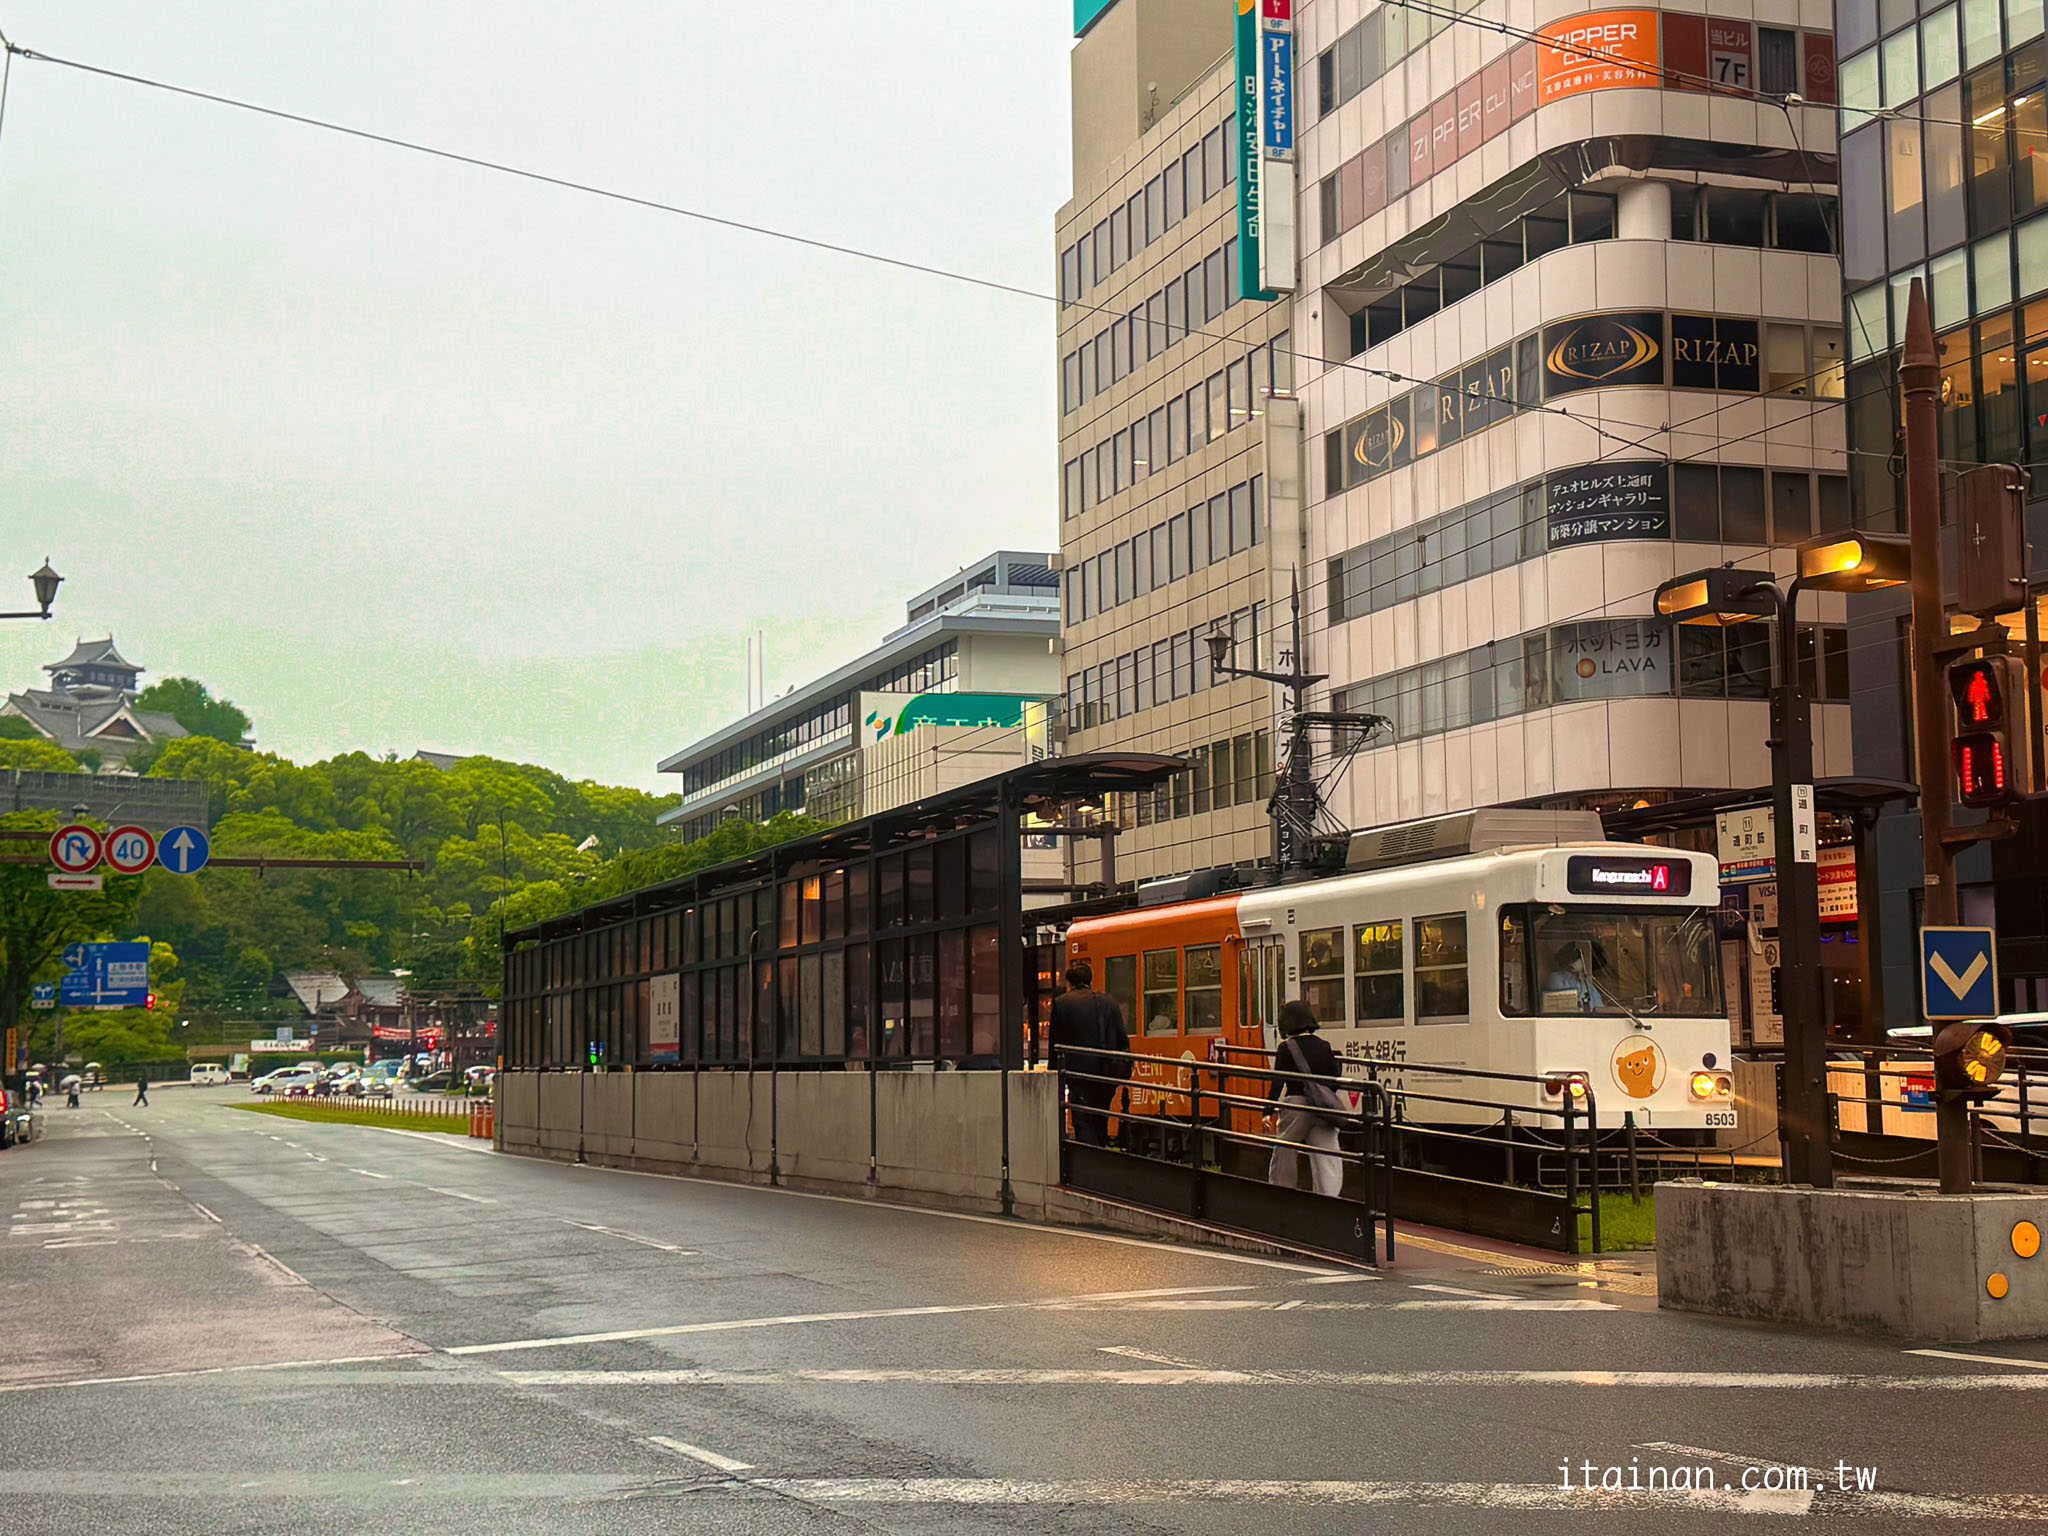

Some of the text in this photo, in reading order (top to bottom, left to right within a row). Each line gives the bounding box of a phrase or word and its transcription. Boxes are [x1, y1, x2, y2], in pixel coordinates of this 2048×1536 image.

[1551, 23, 1637, 54] ZIPPER
[1711, 29, 1749, 47] 当ビル
[1715, 57, 1746, 84] 7F
[1414, 99, 1482, 162] ZIPPER
[1567, 340, 1630, 361] RIZAP
[1673, 337, 1758, 366] RIZAP
[1441, 366, 1512, 425] RZAP
[1548, 492, 1662, 514] マンションギャラリー
[1550, 517, 1665, 541] 新築分譲マンション
[1568, 629, 1663, 654] ホットヨガ
[1602, 656, 1656, 674] LAVA
[116, 839, 145, 860] 40
[1653, 866, 1668, 889] A
[1758, 885, 1776, 897] VISA
[1705, 1112, 1735, 1126] 8503
